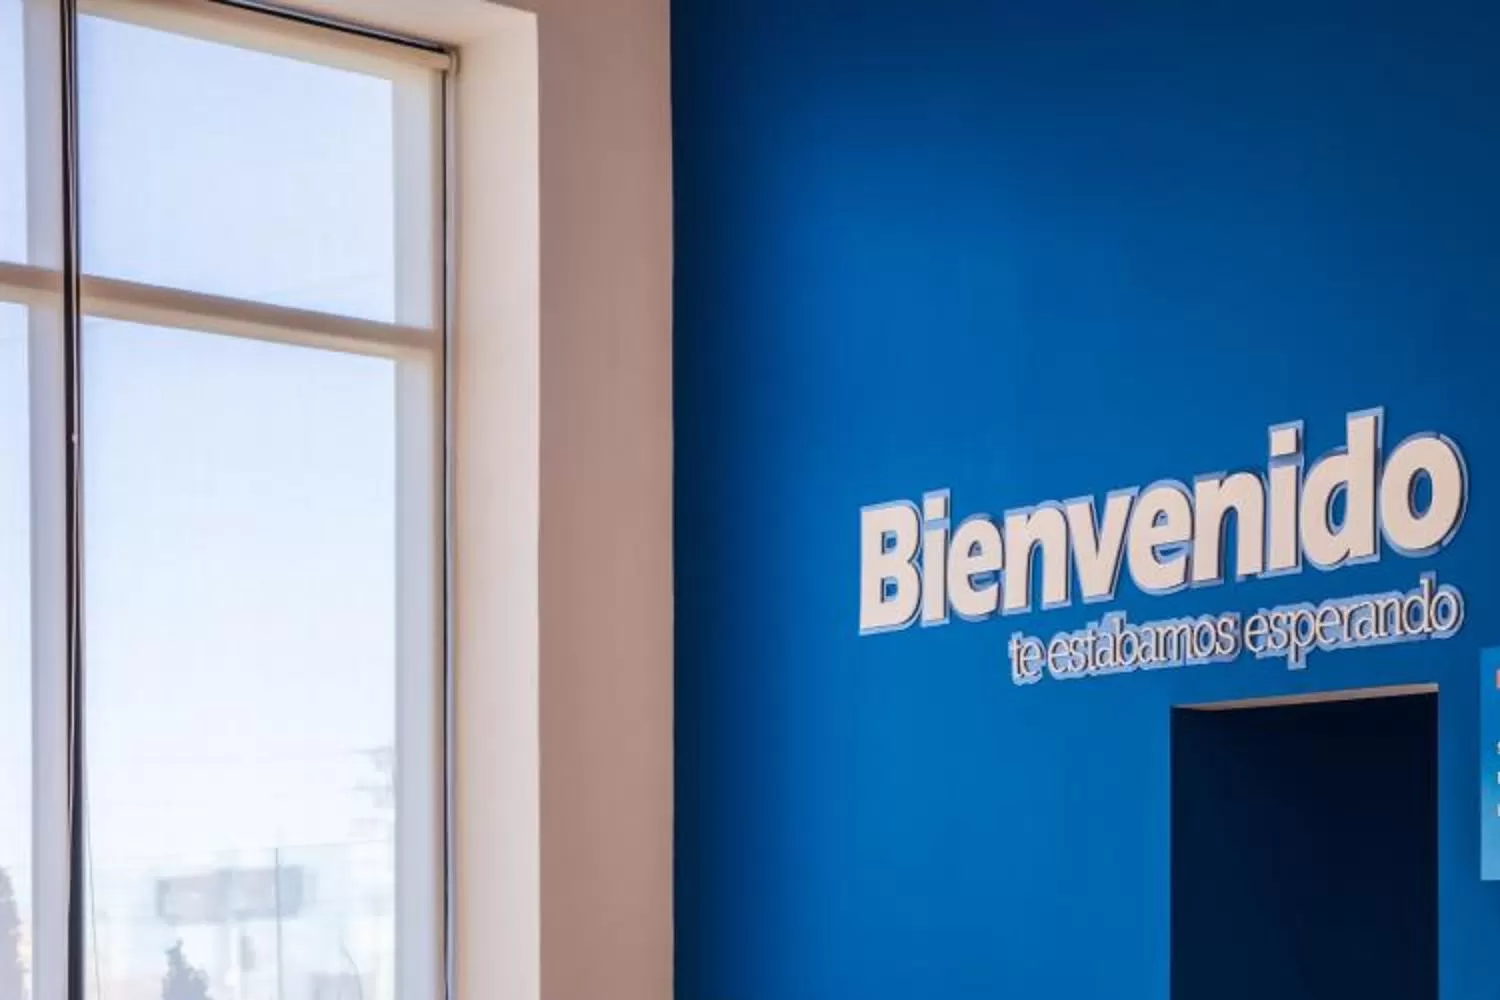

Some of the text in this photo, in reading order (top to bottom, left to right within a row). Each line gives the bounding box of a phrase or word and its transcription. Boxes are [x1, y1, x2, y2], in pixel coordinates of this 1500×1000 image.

[858, 408, 1468, 634] Bienvenido
[1010, 634, 1044, 681] te
[1243, 574, 1463, 667] esperando
